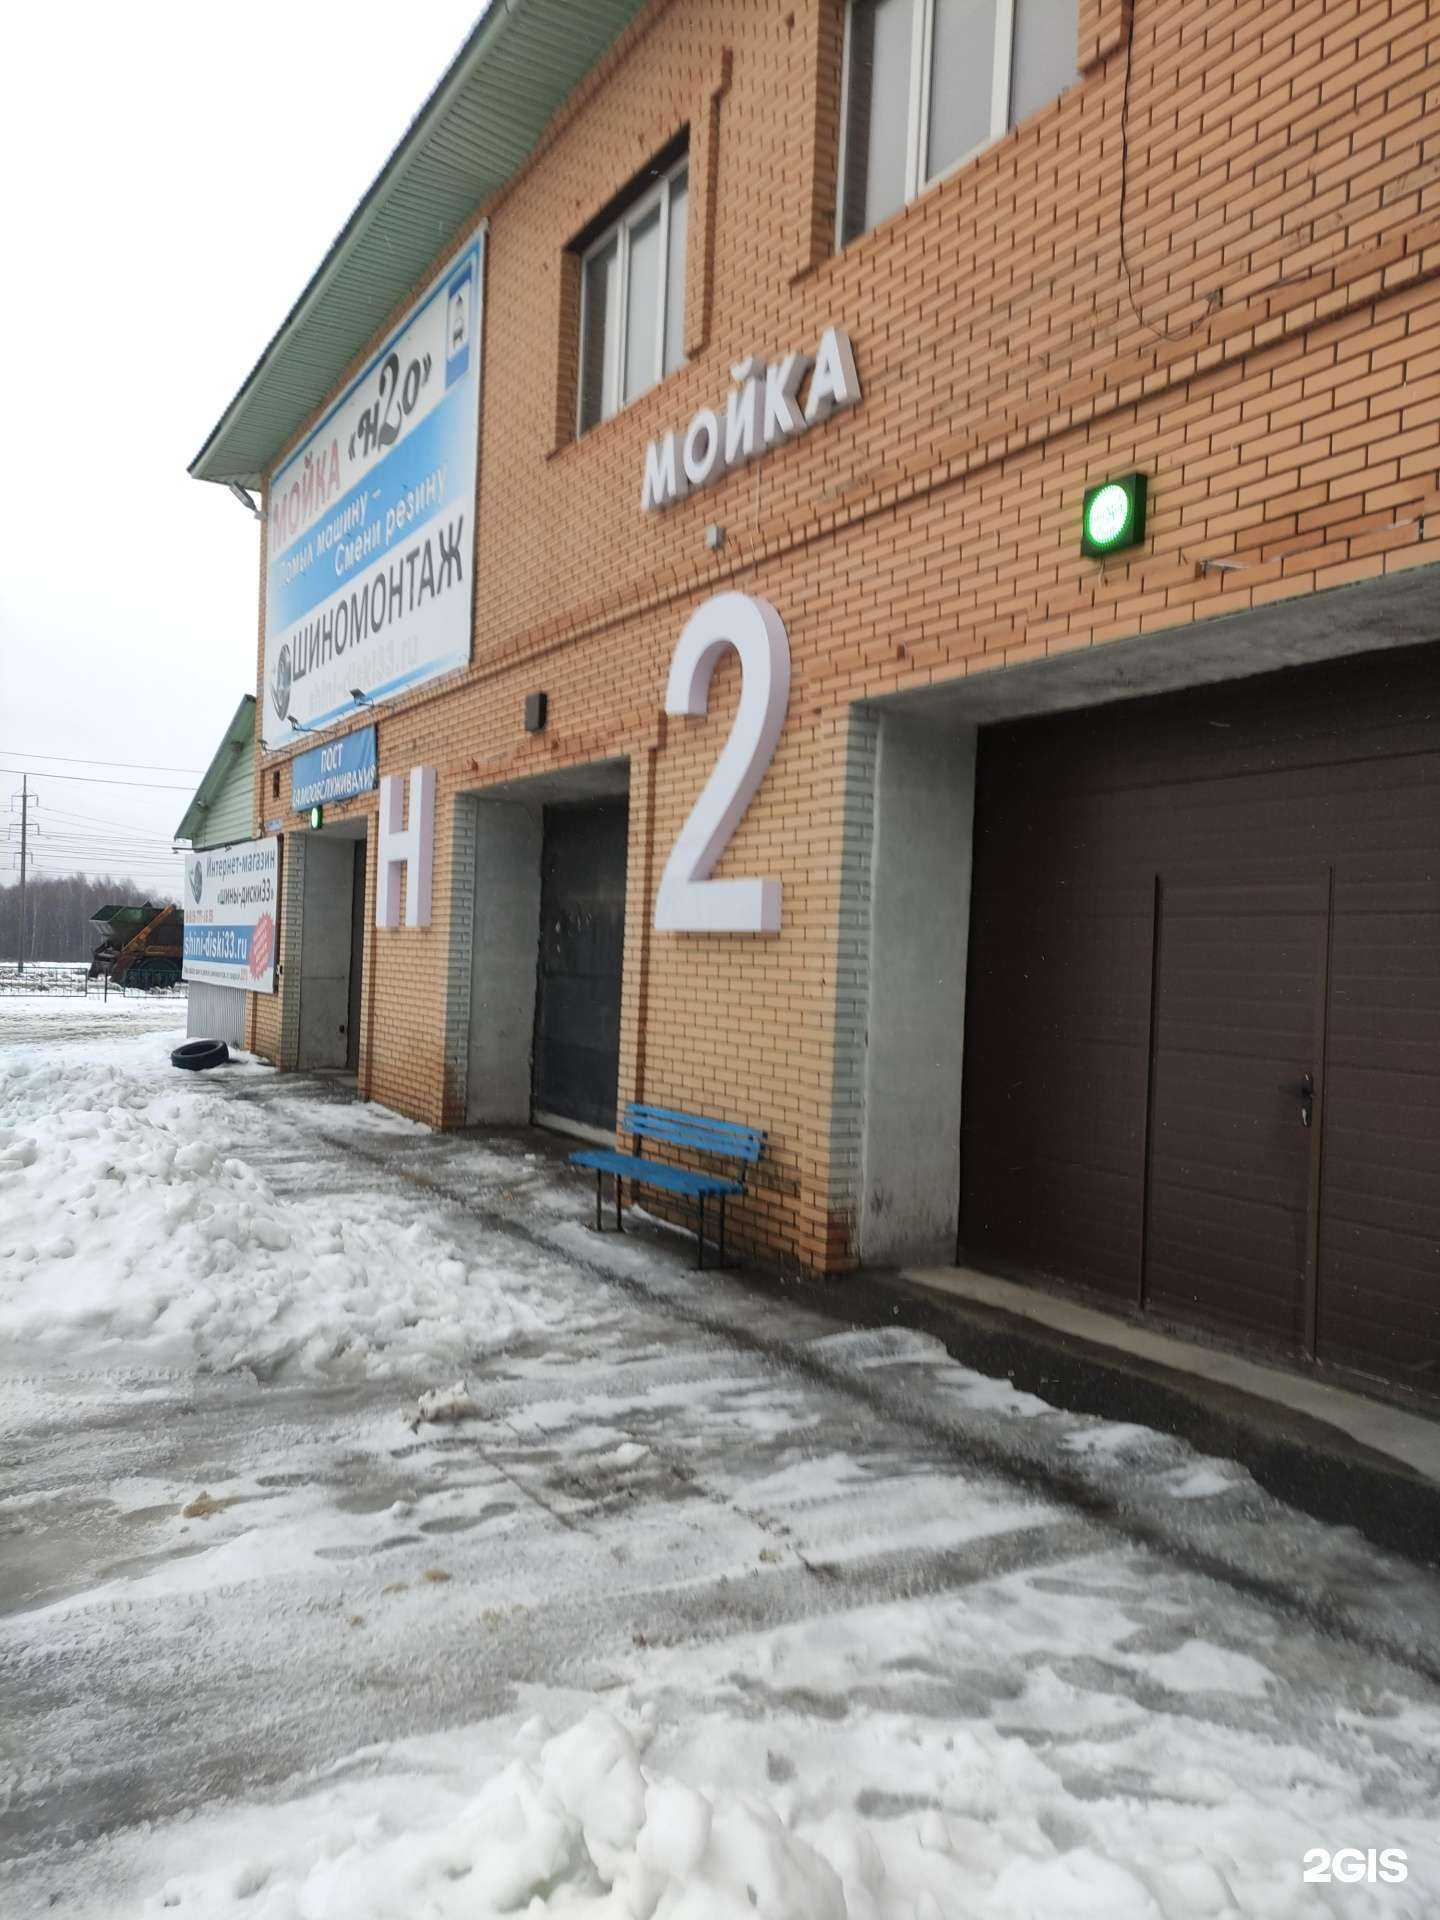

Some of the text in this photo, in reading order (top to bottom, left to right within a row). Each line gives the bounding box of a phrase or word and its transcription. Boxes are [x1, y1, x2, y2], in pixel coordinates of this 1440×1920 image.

[641, 327, 860, 512] МОЙКА
[272, 438, 341, 551] МОЙКА
[316, 489, 369, 558] машину
[335, 460, 448, 577] Смени резину
[292, 514, 464, 682] ШИНОМОНТАЖ
[320, 743, 344, 773] ПОСТ
[654, 591, 791, 931] 2
[206, 850, 275, 881] Интернет-магазин
[184, 930, 248, 961] shini-diski33.ru
